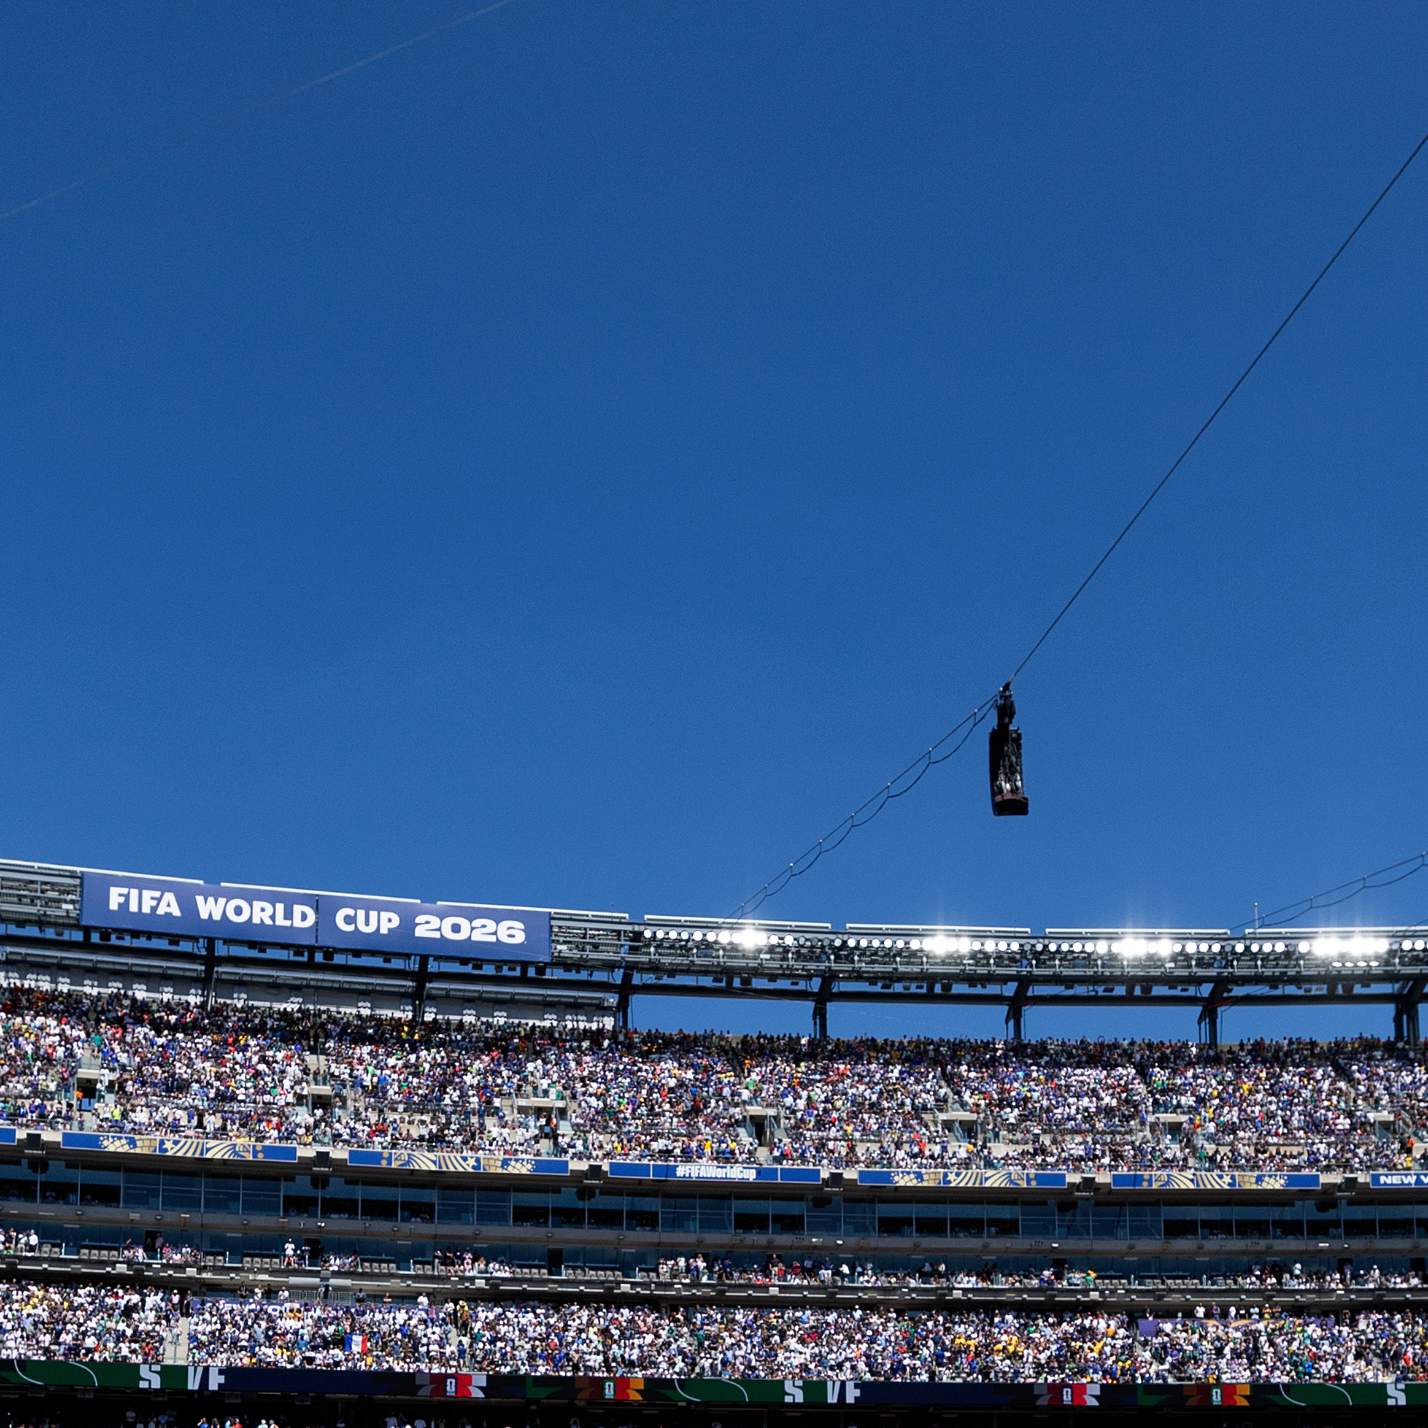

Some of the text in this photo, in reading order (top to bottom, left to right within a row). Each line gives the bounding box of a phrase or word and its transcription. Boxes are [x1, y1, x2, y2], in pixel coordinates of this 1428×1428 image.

[108, 886, 527, 944] FIFA WORLD CUP 2026
[675, 1165, 757, 1181] #FIFAWorldCup
[1379, 1174, 1417, 1185] NEW
